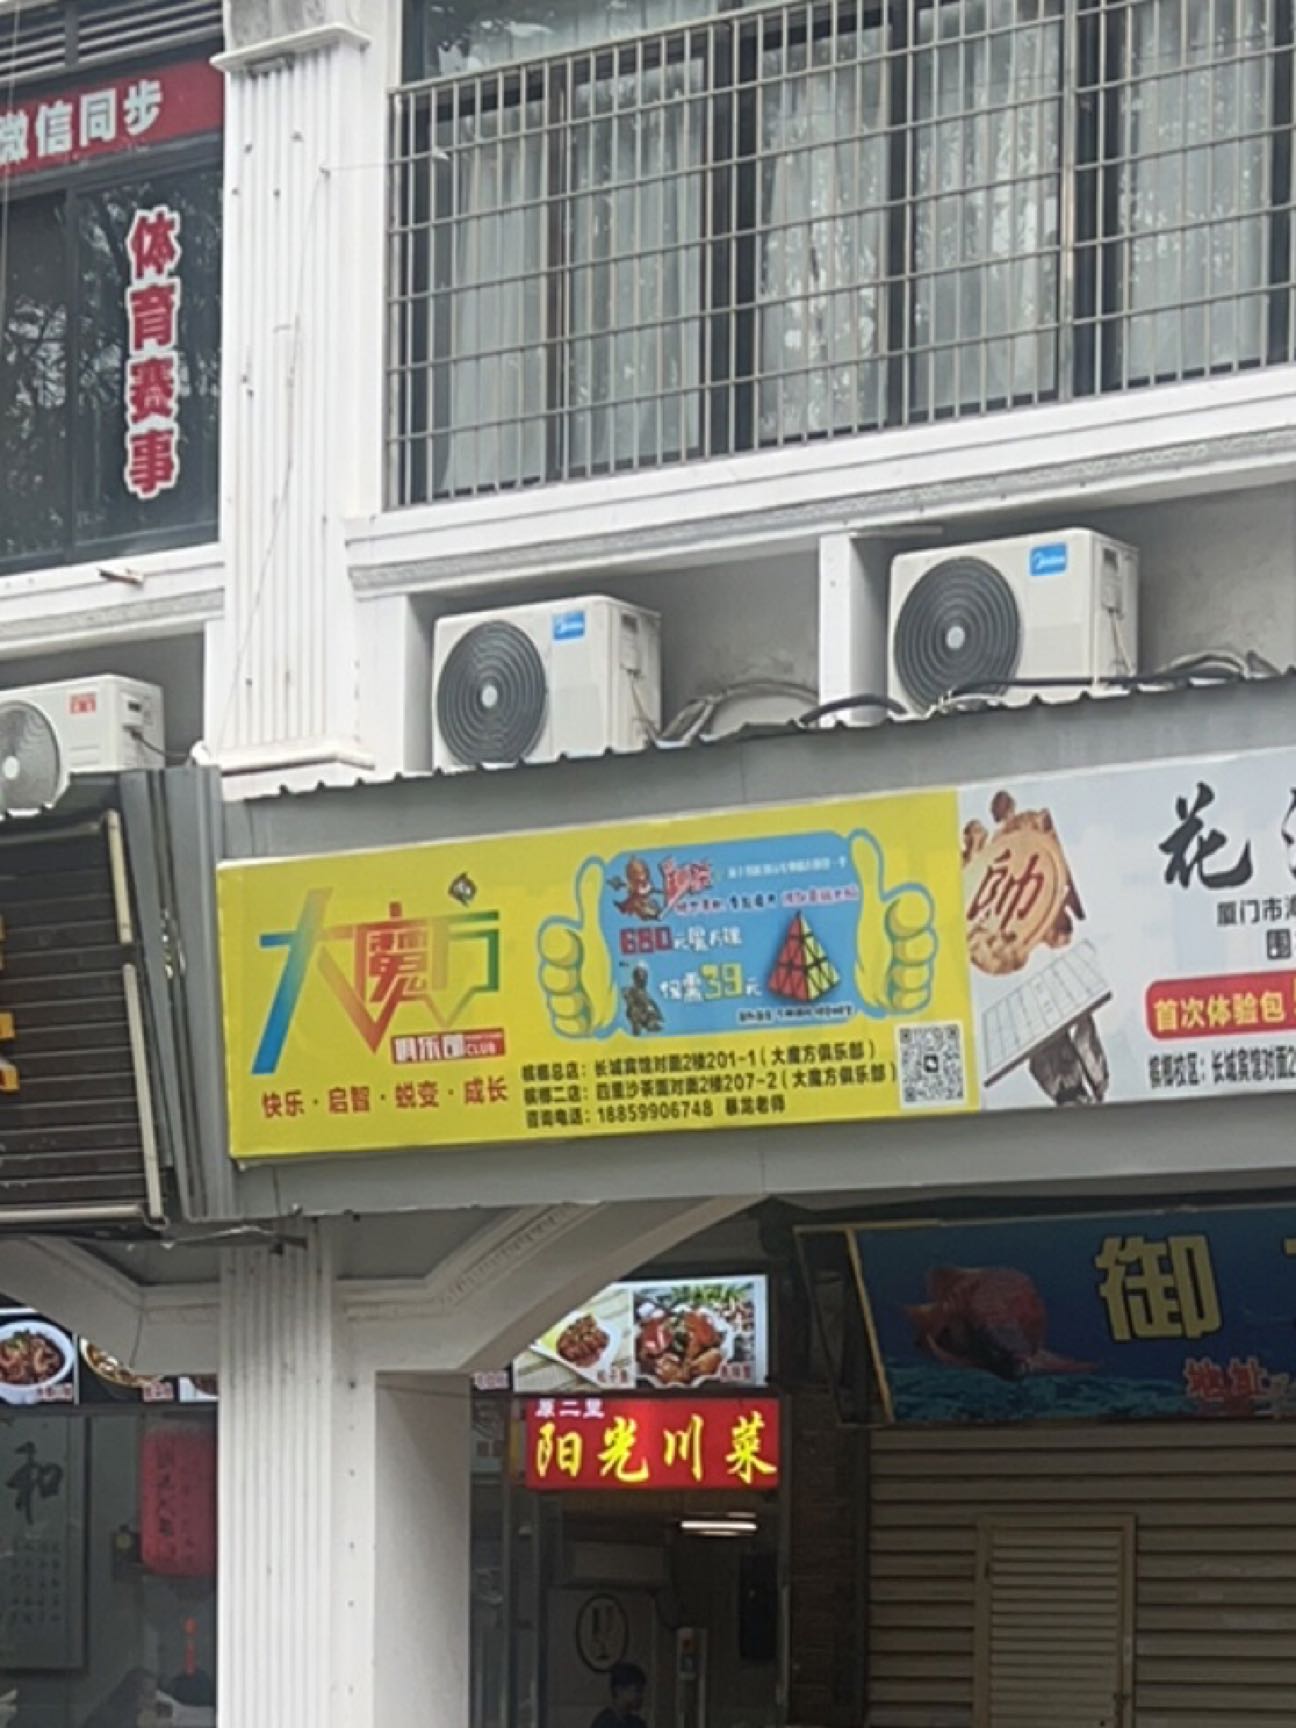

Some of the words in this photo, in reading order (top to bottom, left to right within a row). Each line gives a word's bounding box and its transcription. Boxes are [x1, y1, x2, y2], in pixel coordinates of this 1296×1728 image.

[0, 79, 163, 166] 微信同步
[126, 207, 181, 498] 体育赛事
[1153, 990, 1286, 1033] 首次体验包
[535, 1410, 779, 1484] 阳光川菜
